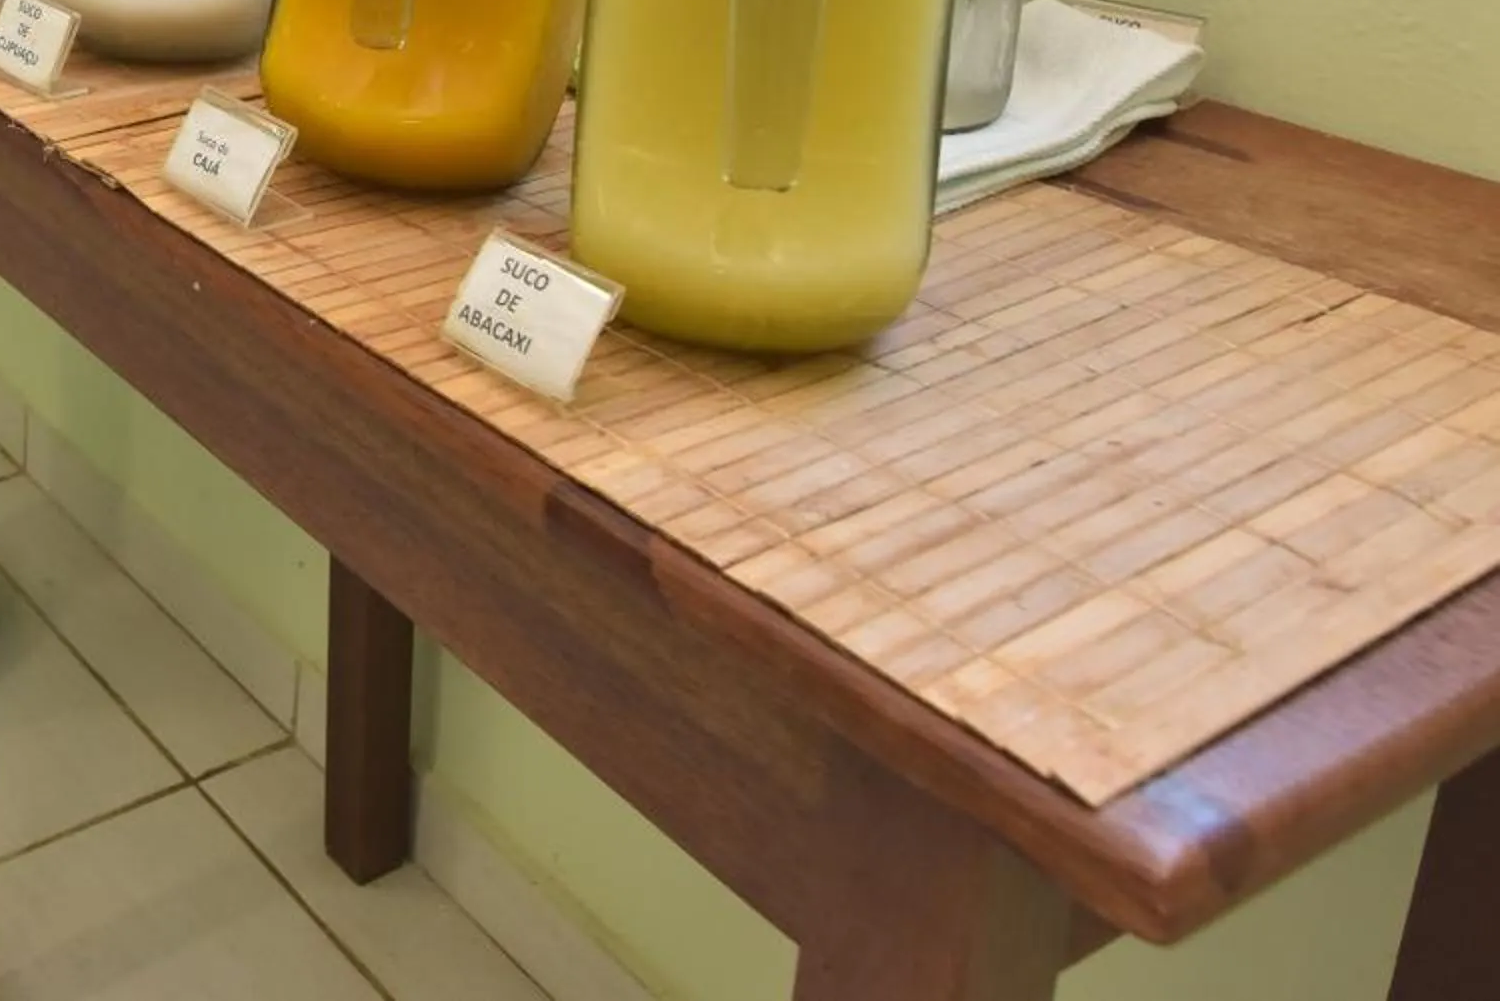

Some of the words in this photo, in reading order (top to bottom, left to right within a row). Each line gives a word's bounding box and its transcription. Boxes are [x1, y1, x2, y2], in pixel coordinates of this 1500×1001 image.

[18, 0, 43, 19] SUCO
[17, 22, 30, 38] DE
[196, 130, 217, 150] Suco
[217, 142, 229, 156] de
[193, 152, 221, 175] CAJÁ
[500, 257, 549, 291] SUCO
[495, 289, 523, 314] DE
[458, 304, 533, 355] ABACAXI
